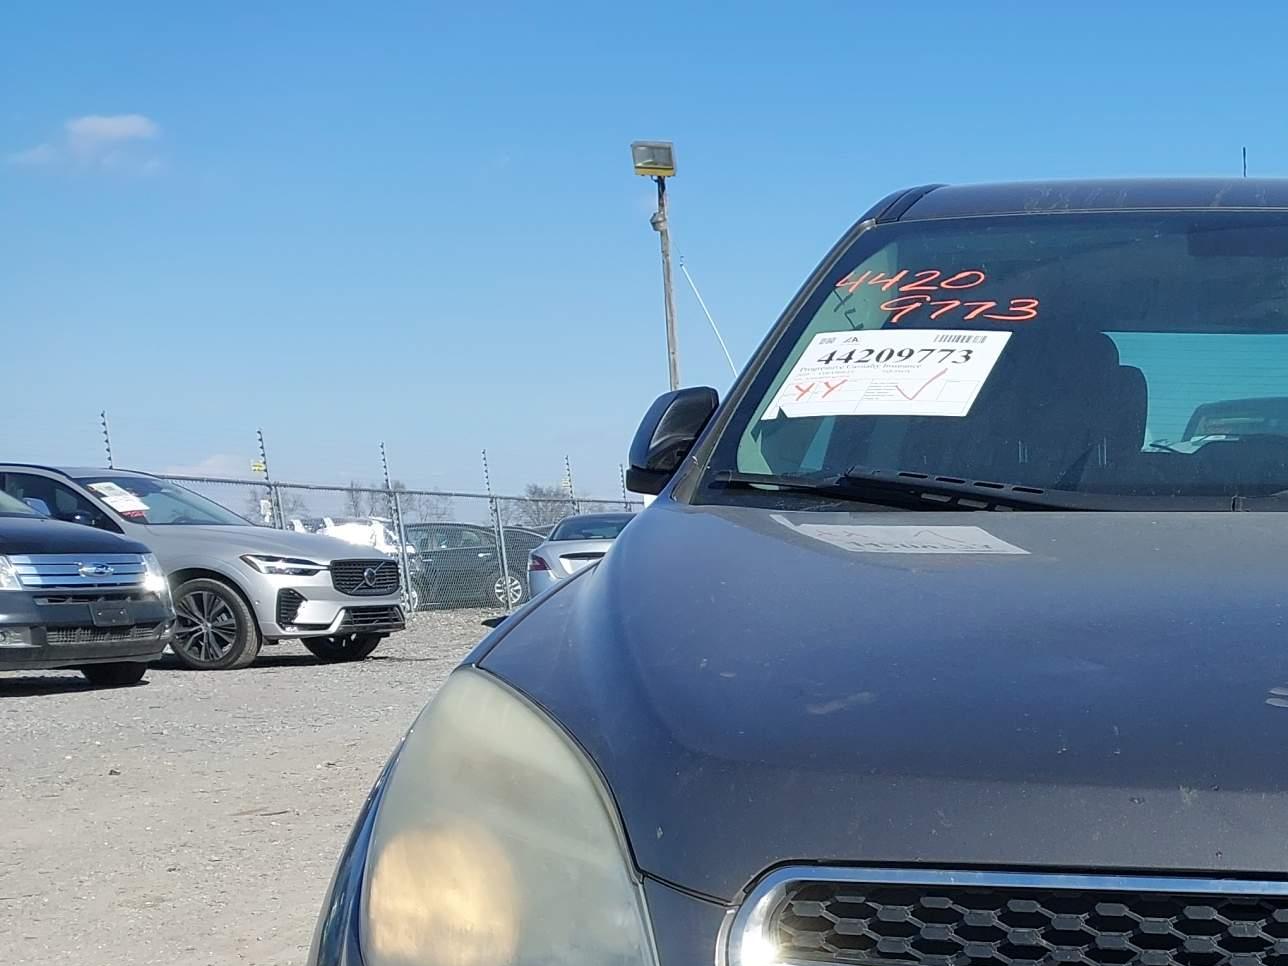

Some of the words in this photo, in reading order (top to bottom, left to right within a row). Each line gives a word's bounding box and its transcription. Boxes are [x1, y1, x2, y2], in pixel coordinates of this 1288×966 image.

[834, 269, 985, 292] 4420
[879, 294, 1040, 323] 9773
[816, 348, 975, 365] 44209773
